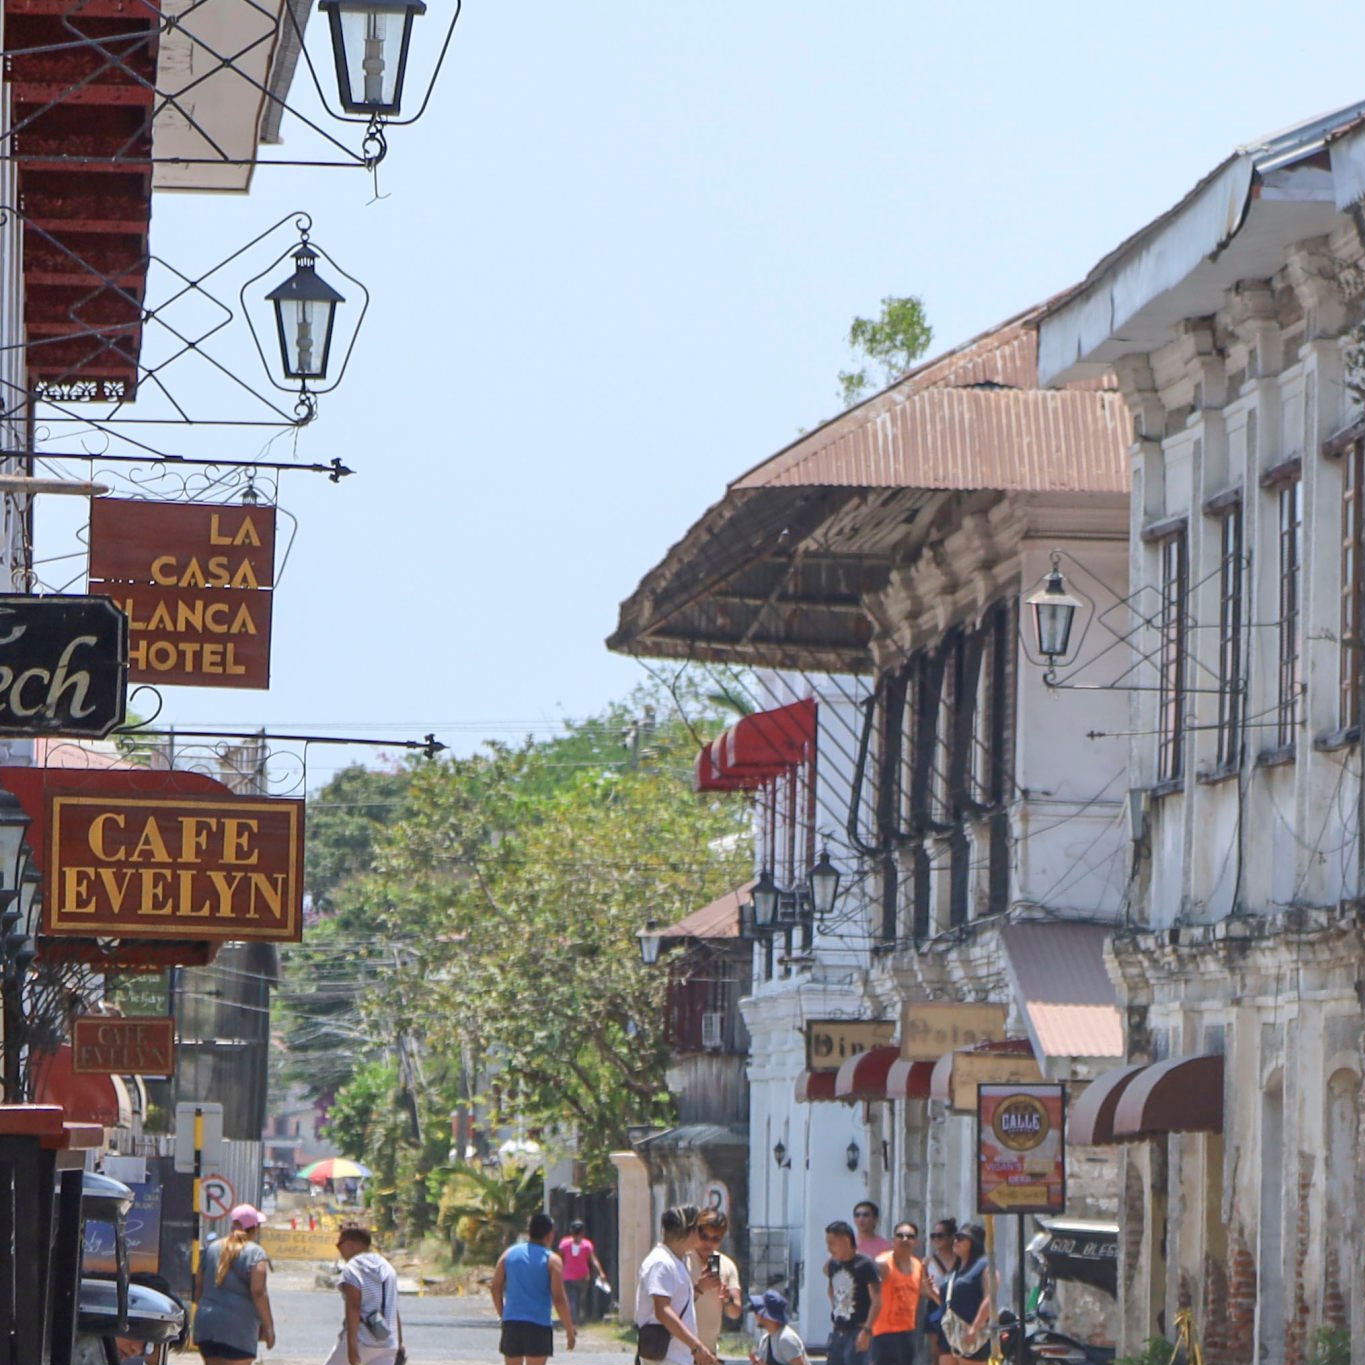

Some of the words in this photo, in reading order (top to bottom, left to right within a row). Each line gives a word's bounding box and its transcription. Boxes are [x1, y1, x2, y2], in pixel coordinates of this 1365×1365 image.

[210, 514, 261, 546] LA
[151, 556, 258, 590] CASA
[112, 599, 257, 635] LANCA
[128, 639, 246, 675] HOTEL
[88, 812, 259, 865] CAFE
[61, 867, 287, 919] EVELYN
[98, 1026, 147, 1045] CAFE
[80, 1047, 166, 1068] EVELYN
[1002, 1113, 1040, 1131] CALLE
